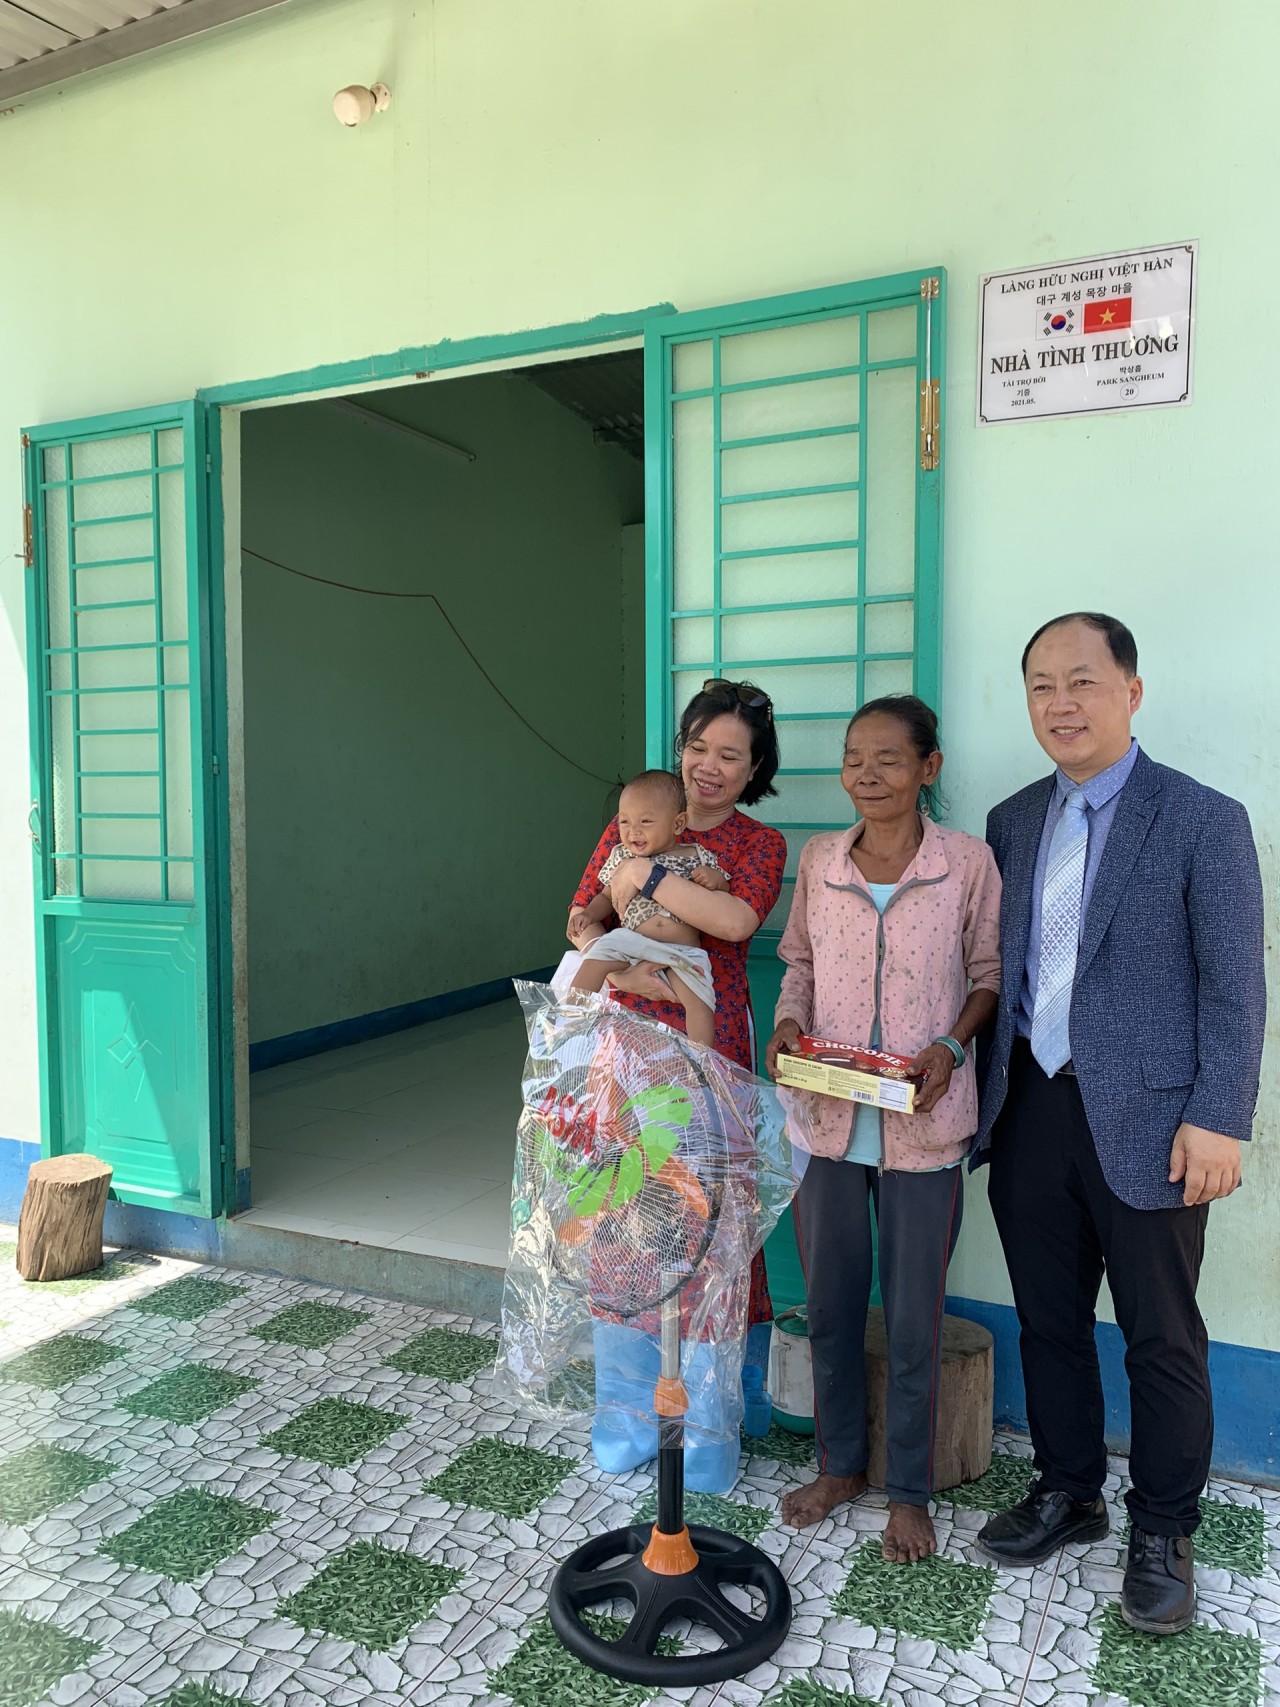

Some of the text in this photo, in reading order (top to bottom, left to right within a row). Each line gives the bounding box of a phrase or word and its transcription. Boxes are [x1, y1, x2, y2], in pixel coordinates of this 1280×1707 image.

[1001, 257, 1174, 294] LÀNG HỮU NGHỊ VIỆT HÀN
[1036, 282, 1133, 306] 대구 계성 목장 마을
[990, 334, 1179, 374] NHÀ TÌNH THƯƠNG
[1002, 380, 1015, 388] TÀI
[1096, 373, 1165, 386] PARK SANGHEUM
[1017, 389, 1030, 397] 기증
[1125, 388, 1134, 396] 20
[1011, 399, 1036, 407] 2021.05.
[812, 1041, 905, 1067] CHOCOPIE
[533, 1086, 598, 1155] ASIA
